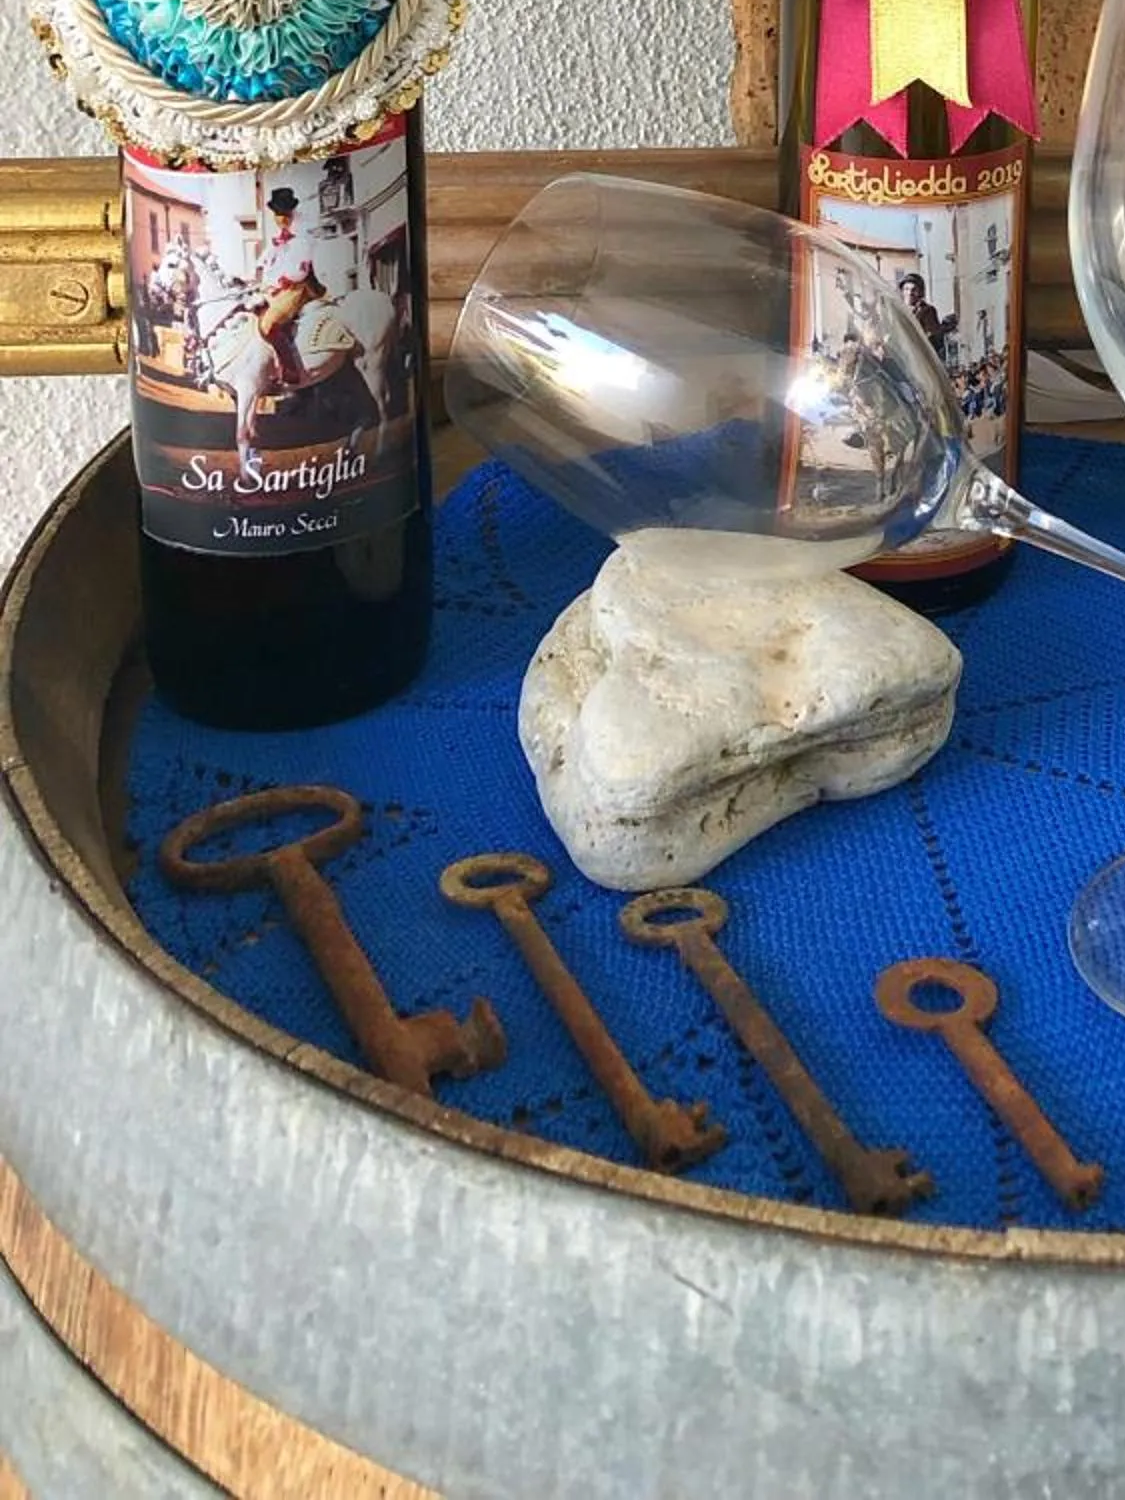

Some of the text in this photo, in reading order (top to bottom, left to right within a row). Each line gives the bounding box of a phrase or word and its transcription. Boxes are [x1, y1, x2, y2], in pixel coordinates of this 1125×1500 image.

[977, 160, 1023, 191] 2019
[181, 448, 365, 499] Sa Sartiglia
[213, 511, 338, 538] Mauro Secci
